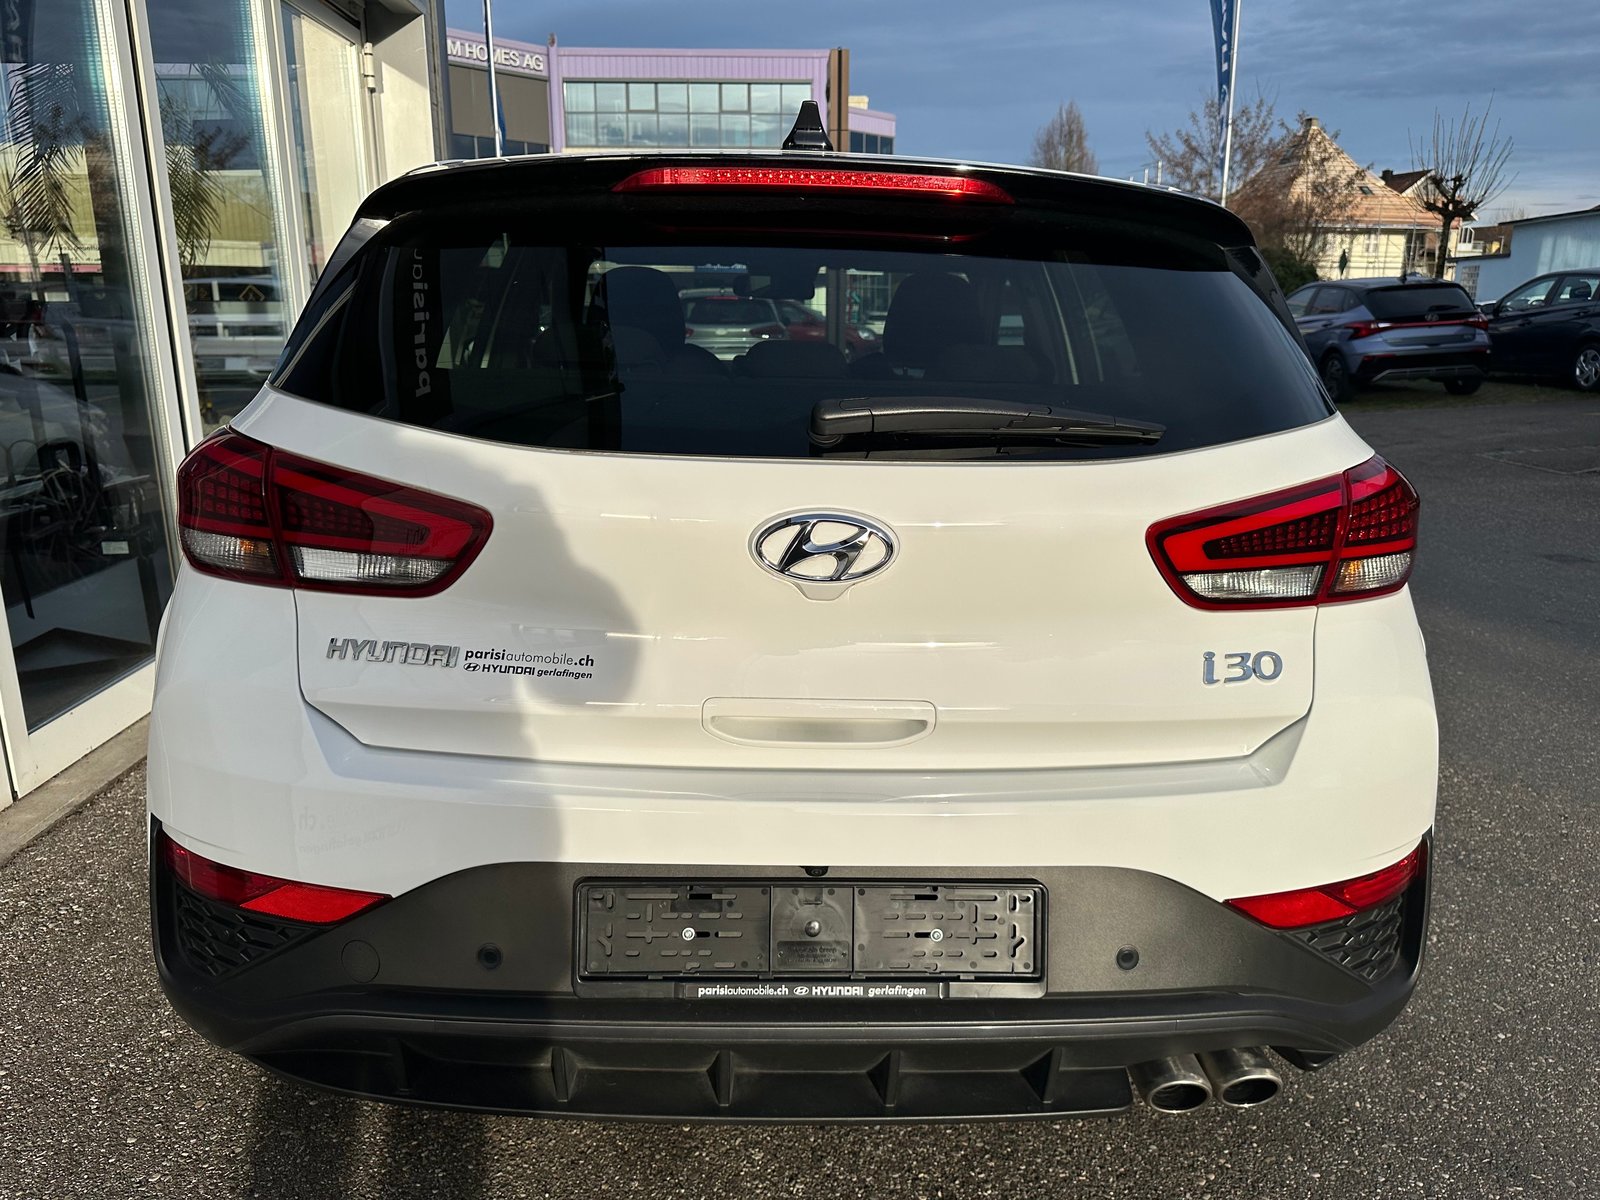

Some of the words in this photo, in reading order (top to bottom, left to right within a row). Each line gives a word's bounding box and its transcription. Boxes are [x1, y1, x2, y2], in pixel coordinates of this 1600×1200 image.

[523, 54, 544, 71] AG
[326, 638, 461, 669] HYUNDAI
[465, 648, 594, 667] parisiautomobile.ch
[482, 665, 535, 676] HYUNDAI
[537, 667, 593, 680] gerlafingen
[1203, 651, 1283, 685] i30
[697, 985, 789, 998] parisiautomobile.ch
[812, 986, 864, 997] HYUNDAI
[868, 985, 927, 998] gerlafingen
